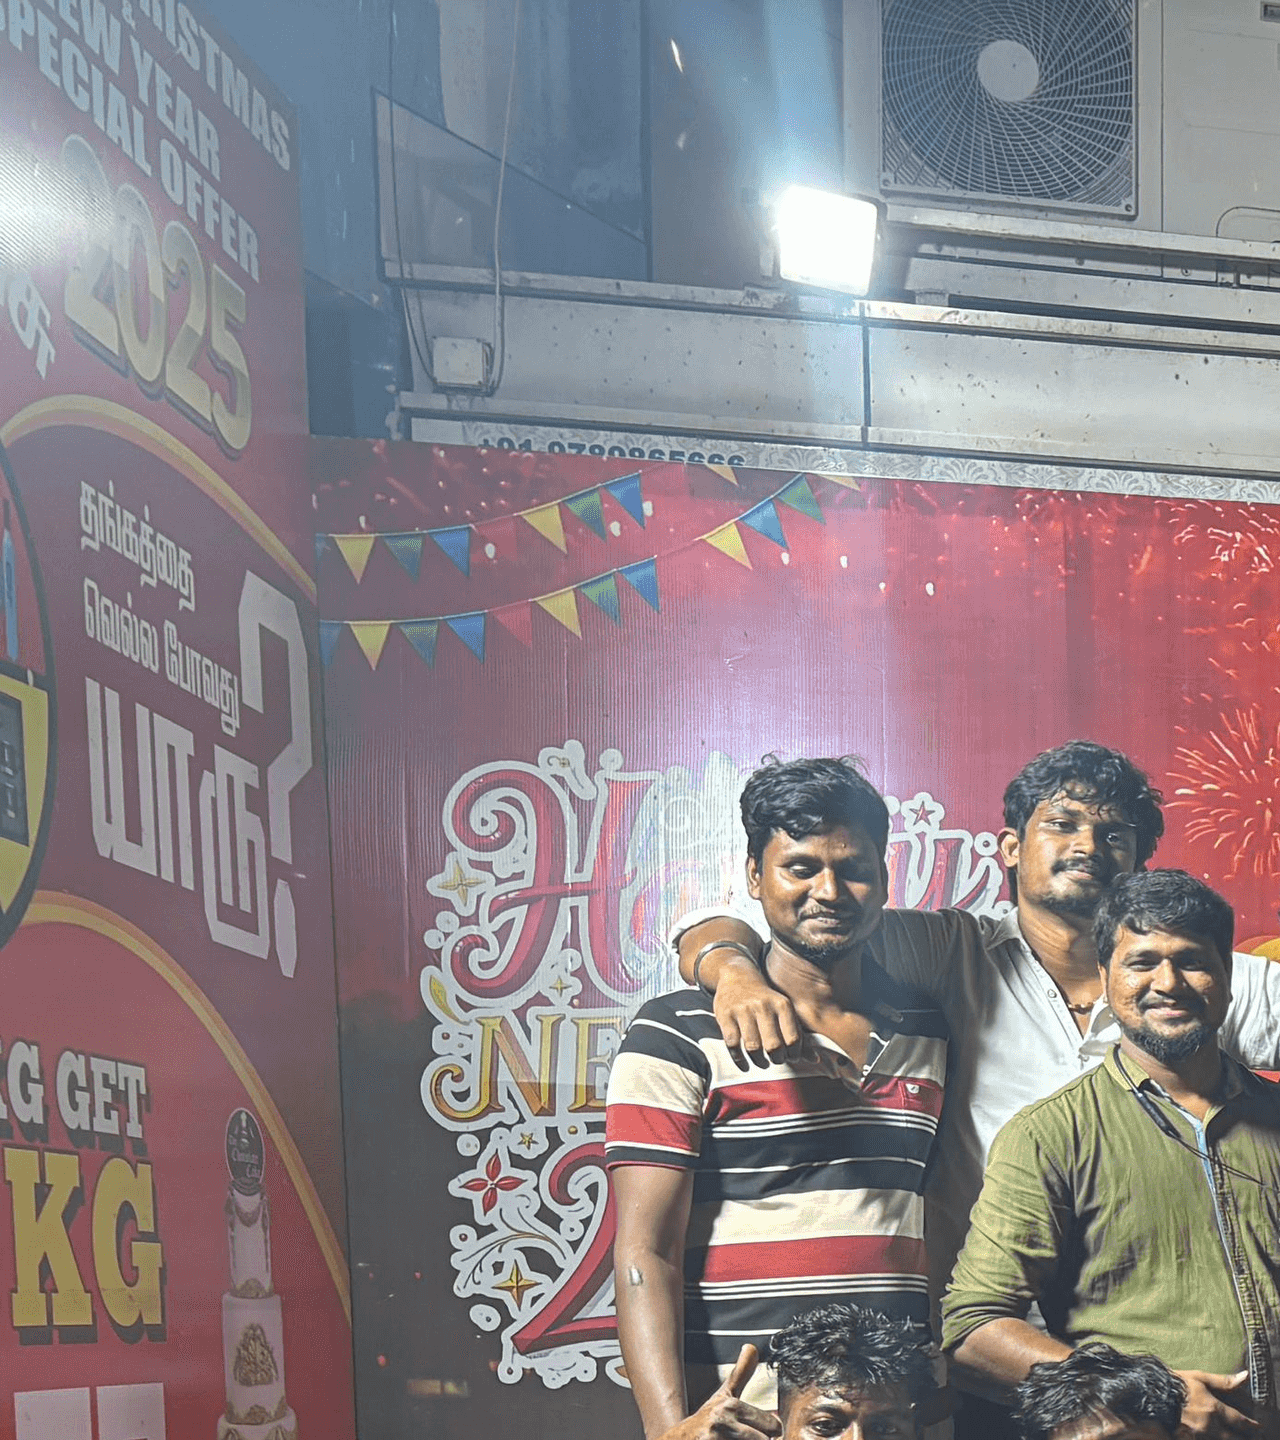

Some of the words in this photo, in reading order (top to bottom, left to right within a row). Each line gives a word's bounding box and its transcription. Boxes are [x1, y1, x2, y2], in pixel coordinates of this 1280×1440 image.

[129, 34, 221, 182] YEAR
[159, 138, 260, 284] OFFER
[60, 133, 252, 450] 2025
[56, 1050, 147, 1139] GET
[4, 1147, 163, 1327] KG
